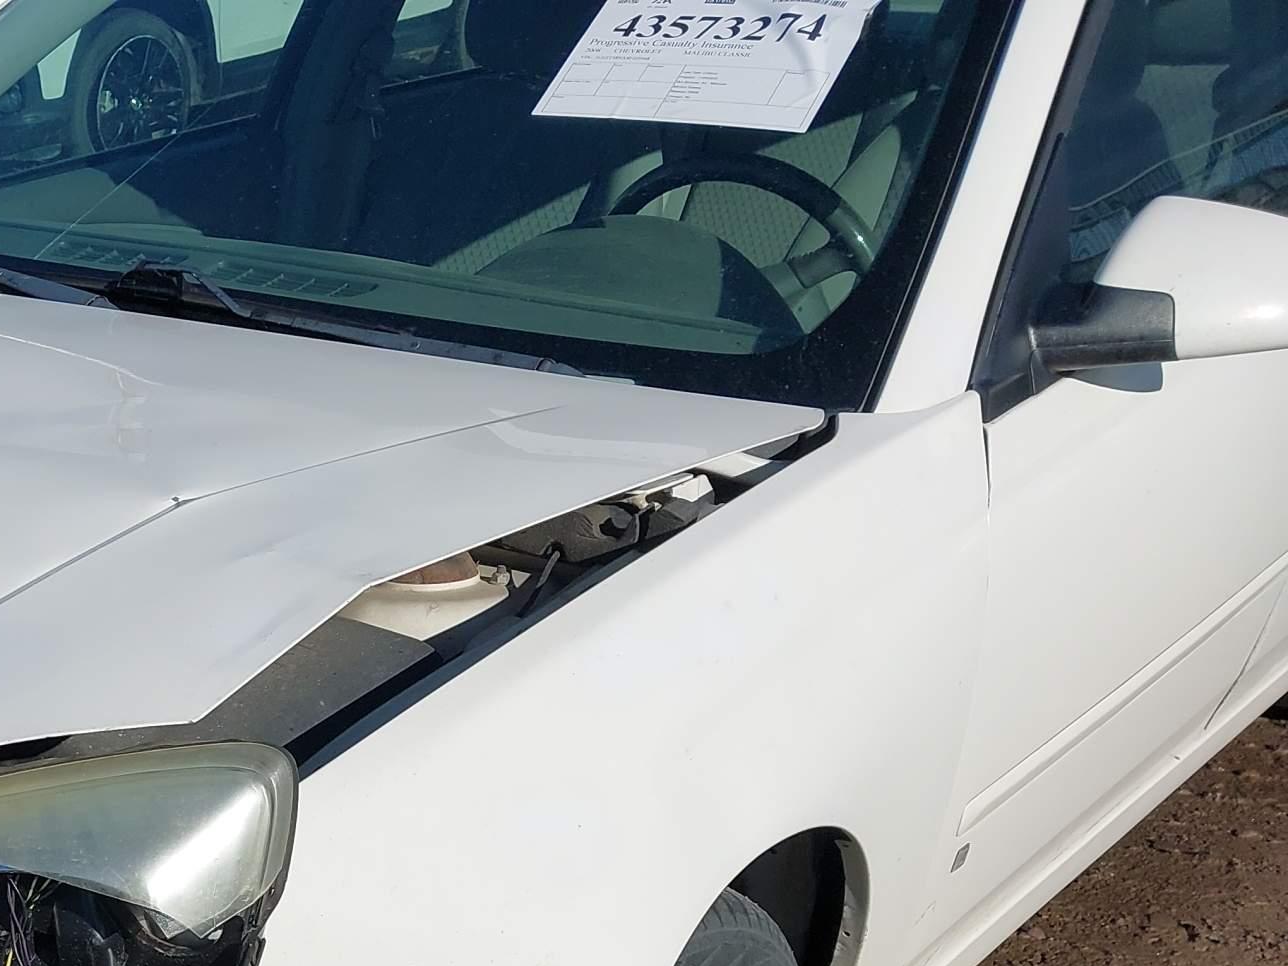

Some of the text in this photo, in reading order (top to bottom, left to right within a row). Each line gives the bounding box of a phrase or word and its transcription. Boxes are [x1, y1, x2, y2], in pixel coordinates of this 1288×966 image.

[613, 13, 827, 43] 43573274
[589, 38, 755, 50] Progressive Casualty Insurance
